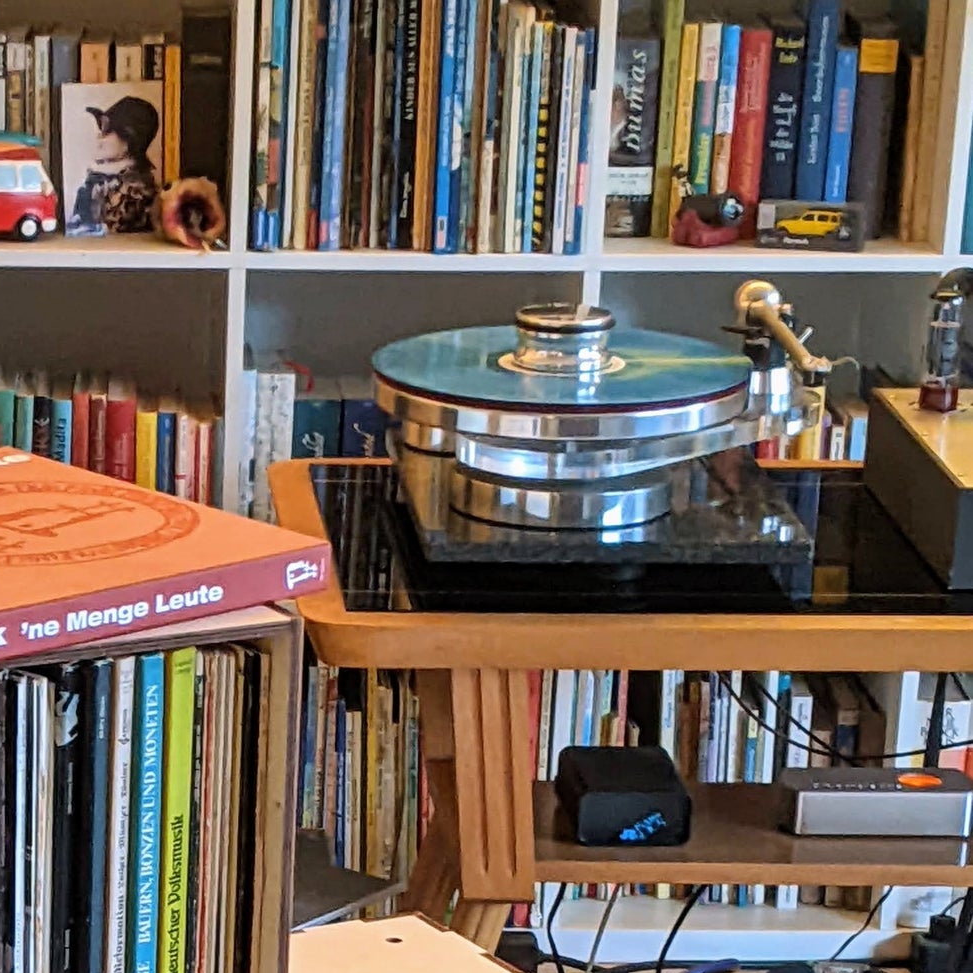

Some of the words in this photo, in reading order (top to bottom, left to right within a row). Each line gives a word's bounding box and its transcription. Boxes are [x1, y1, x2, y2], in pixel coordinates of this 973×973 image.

[621, 49, 648, 154] Dumas
[65, 601, 150, 632] Menge
[154, 584, 225, 614] Leute
[144, 684, 159, 767] MONETEN
[142, 771, 157, 808] UND
[140, 810, 155, 876] BONZEN
[167, 814, 184, 906] Volksmusik
[138, 877, 154, 944] BAUERN,
